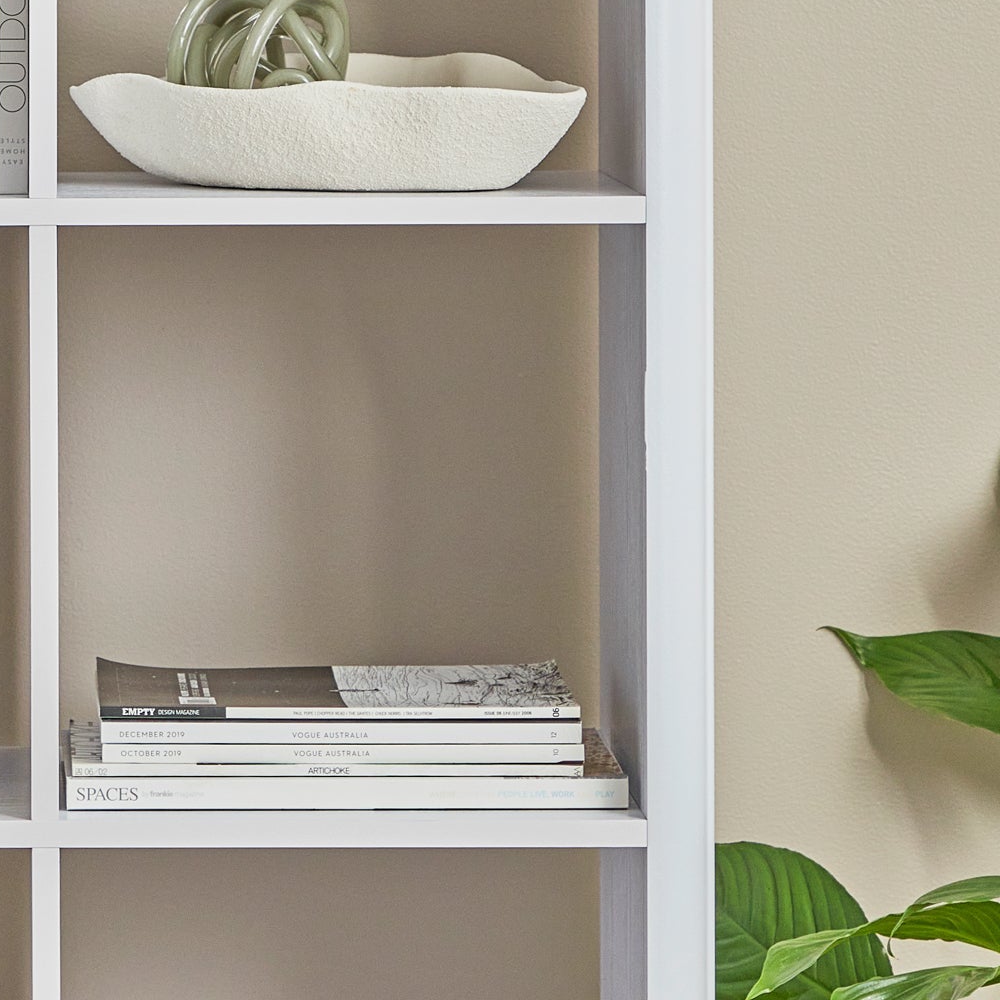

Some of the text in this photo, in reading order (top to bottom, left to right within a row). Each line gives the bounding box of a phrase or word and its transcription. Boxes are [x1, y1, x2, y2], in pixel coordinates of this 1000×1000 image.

[121, 707, 156, 716] EMPTY
[552, 707, 560, 718] 06
[119, 731, 164, 739] DECEMBER
[552, 748, 559, 756] 10
[308, 767, 350, 775] ARTICHOKE
[76, 787, 139, 802] SPACES
[149, 790, 173, 798] frankie
[498, 790, 529, 799] PEOPLE
[551, 790, 576, 799] WORK
[594, 790, 616, 799] PLAY
